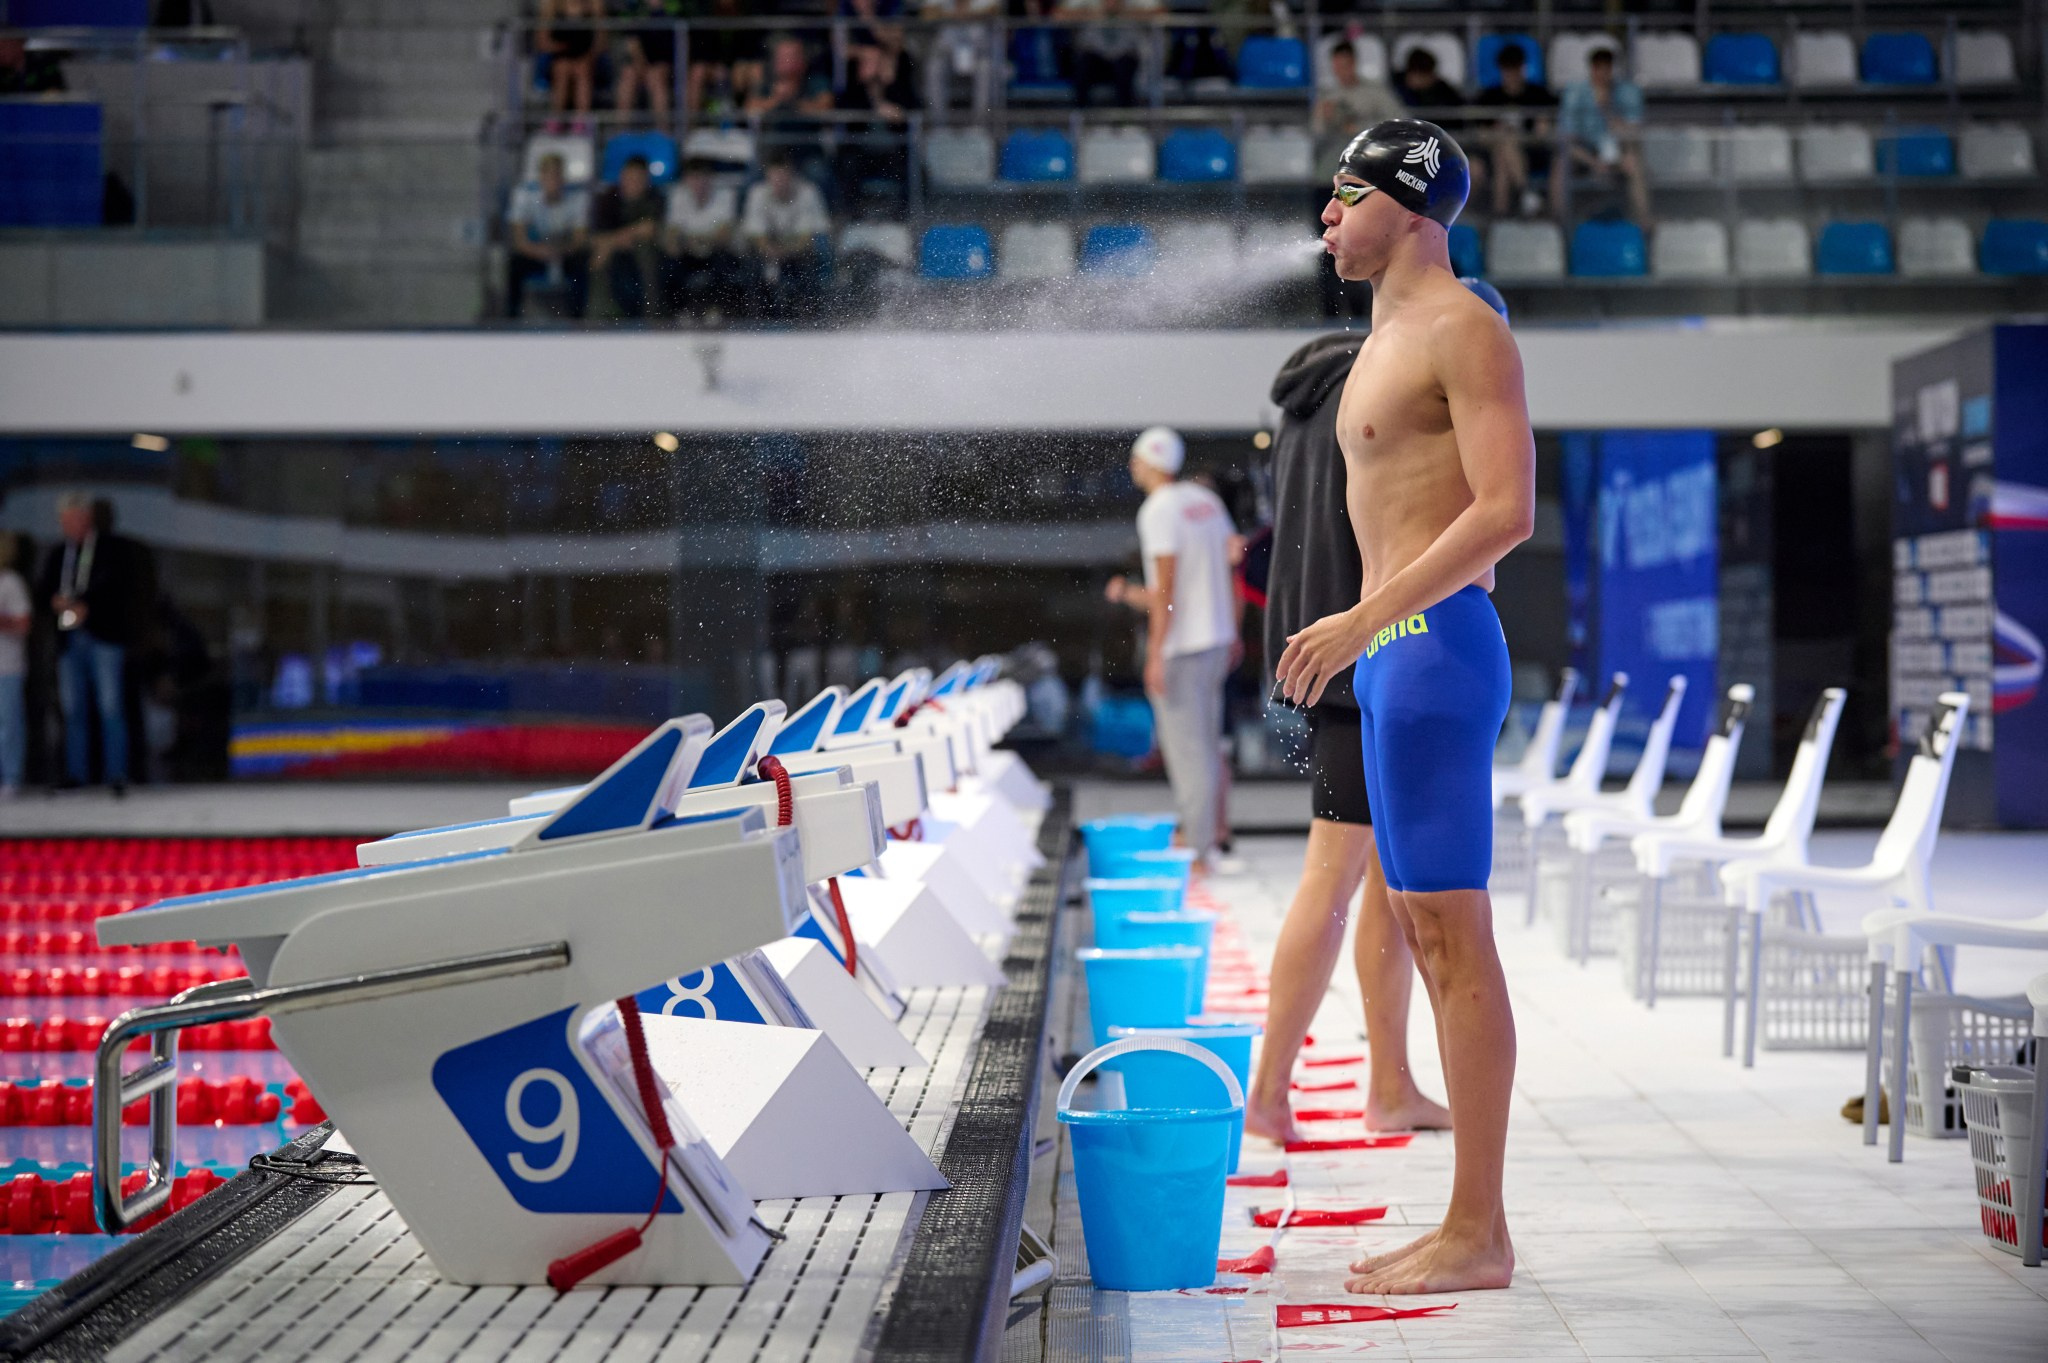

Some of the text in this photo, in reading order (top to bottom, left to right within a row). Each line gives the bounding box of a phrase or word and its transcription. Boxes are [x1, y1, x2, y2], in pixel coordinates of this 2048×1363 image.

[1395, 169, 1427, 193] МОСКВА
[662, 966, 716, 1020] 8
[506, 1067, 580, 1183] 9
